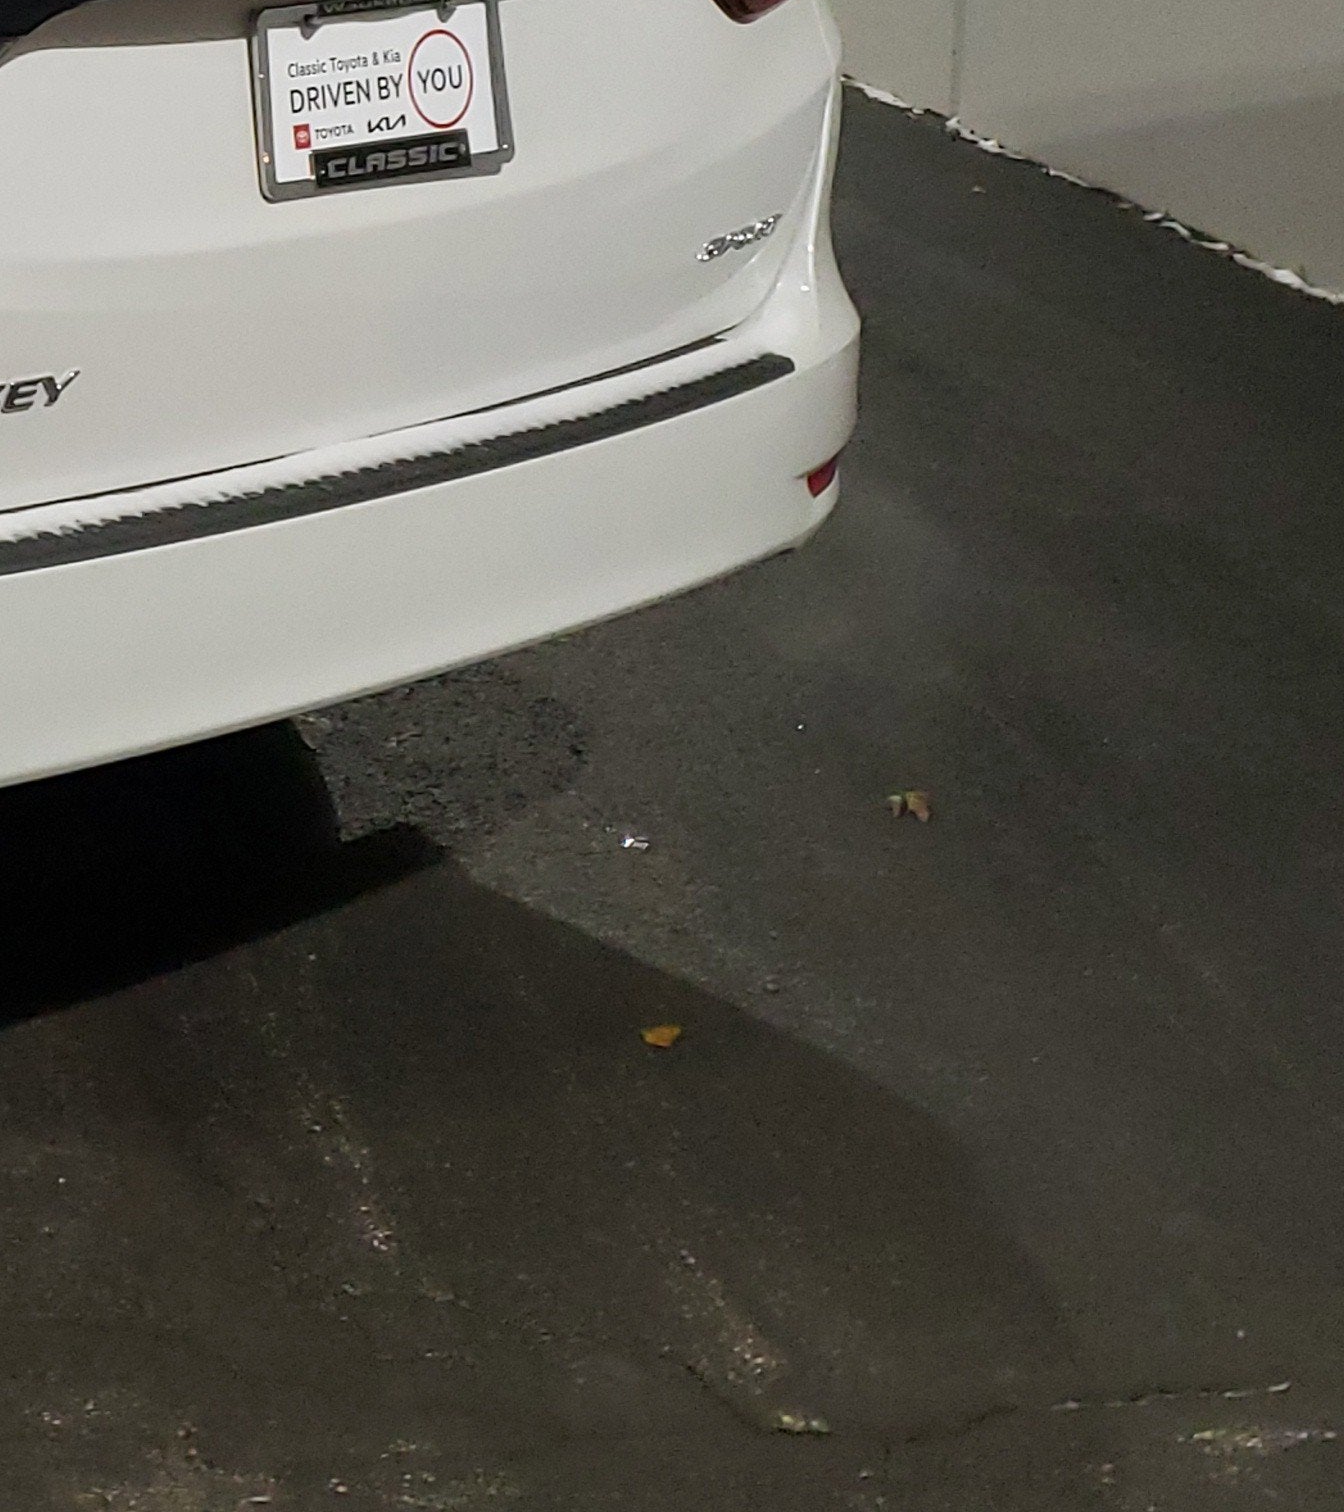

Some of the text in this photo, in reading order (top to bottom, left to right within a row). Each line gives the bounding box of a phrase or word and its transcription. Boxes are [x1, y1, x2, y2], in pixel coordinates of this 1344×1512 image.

[287, 49, 401, 78] Classic Toyota & Kia
[290, 64, 463, 114] DRIVEN BY YOU
[314, 124, 354, 140] TOYOTA
[327, 142, 459, 178] CLASSIC
